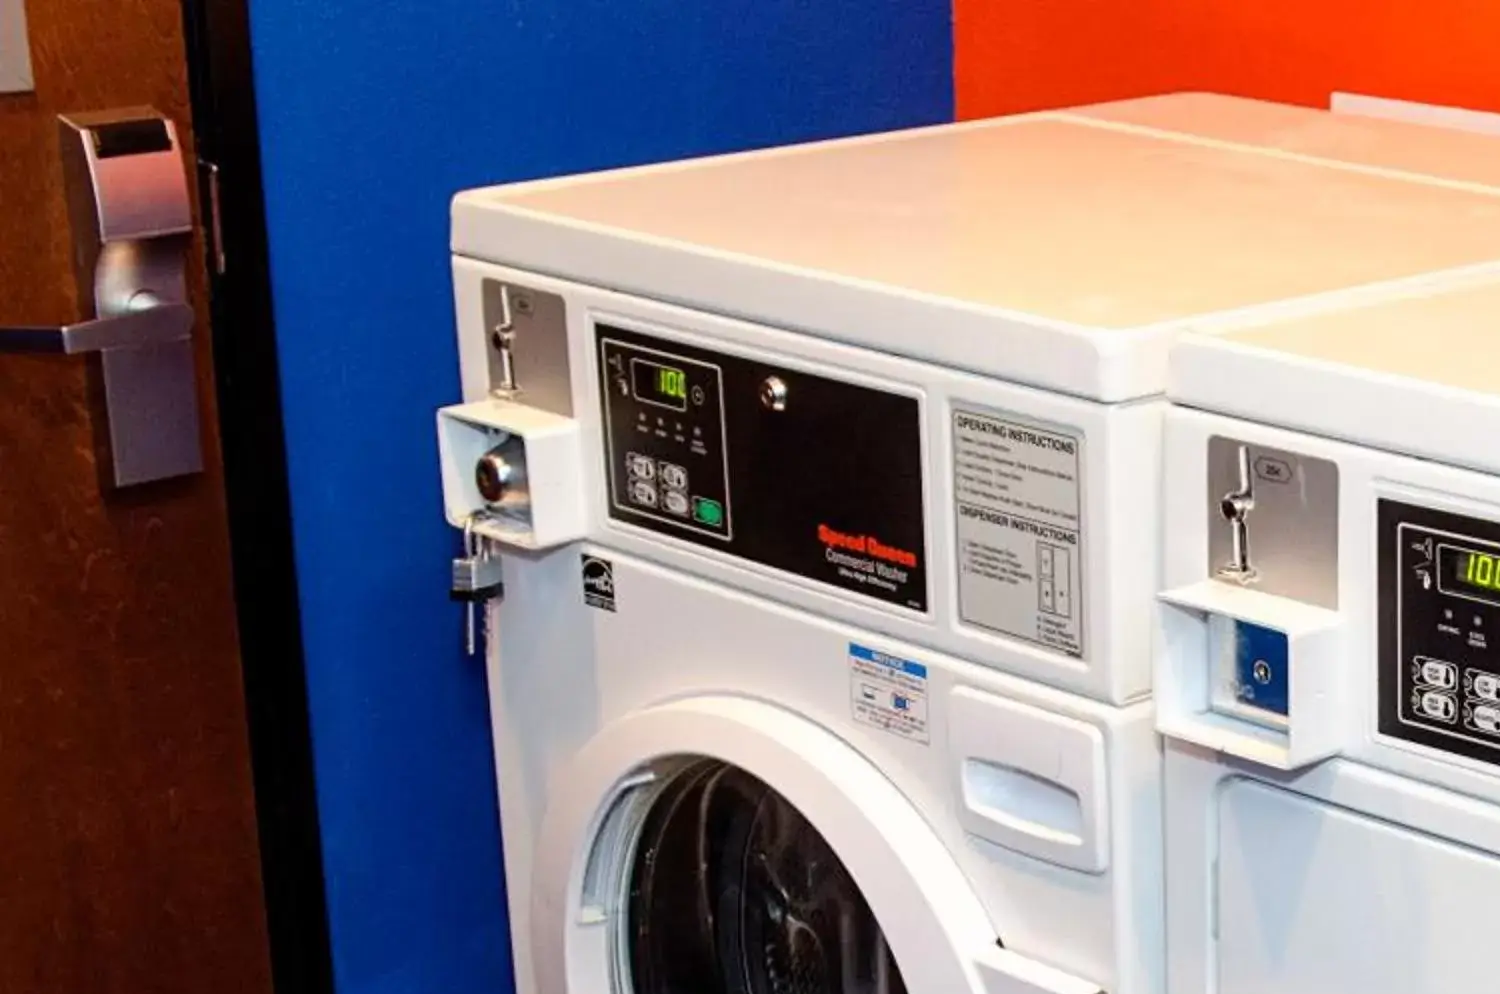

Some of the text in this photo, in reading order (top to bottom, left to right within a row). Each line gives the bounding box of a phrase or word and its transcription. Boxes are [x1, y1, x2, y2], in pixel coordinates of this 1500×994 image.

[957, 415, 1006, 438] OPERATING
[1007, 428, 1074, 455] INSTRUCTIONS
[960, 505, 1076, 544] DISPENSER INSTRUCTIONS
[818, 523, 916, 567] Speed Queen
[826, 547, 875, 573] Commercial
